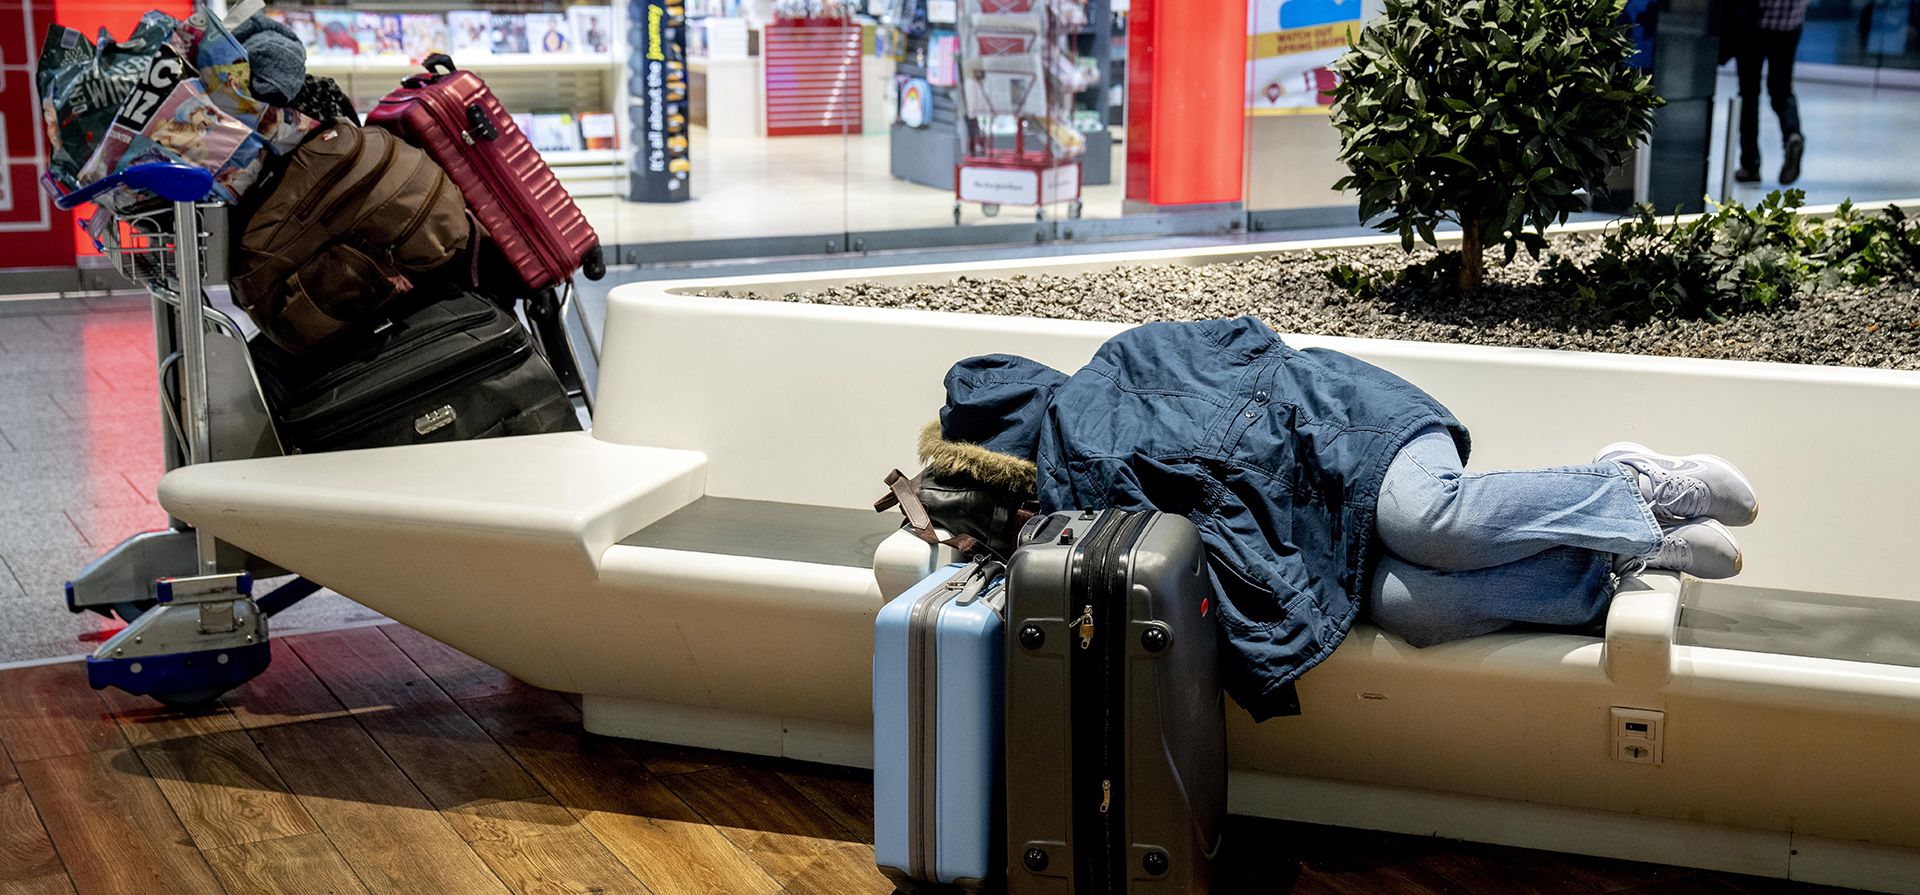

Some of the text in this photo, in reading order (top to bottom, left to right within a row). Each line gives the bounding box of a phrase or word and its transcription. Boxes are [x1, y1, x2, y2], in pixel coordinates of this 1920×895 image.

[646, 4, 664, 171] It's all about the journey
